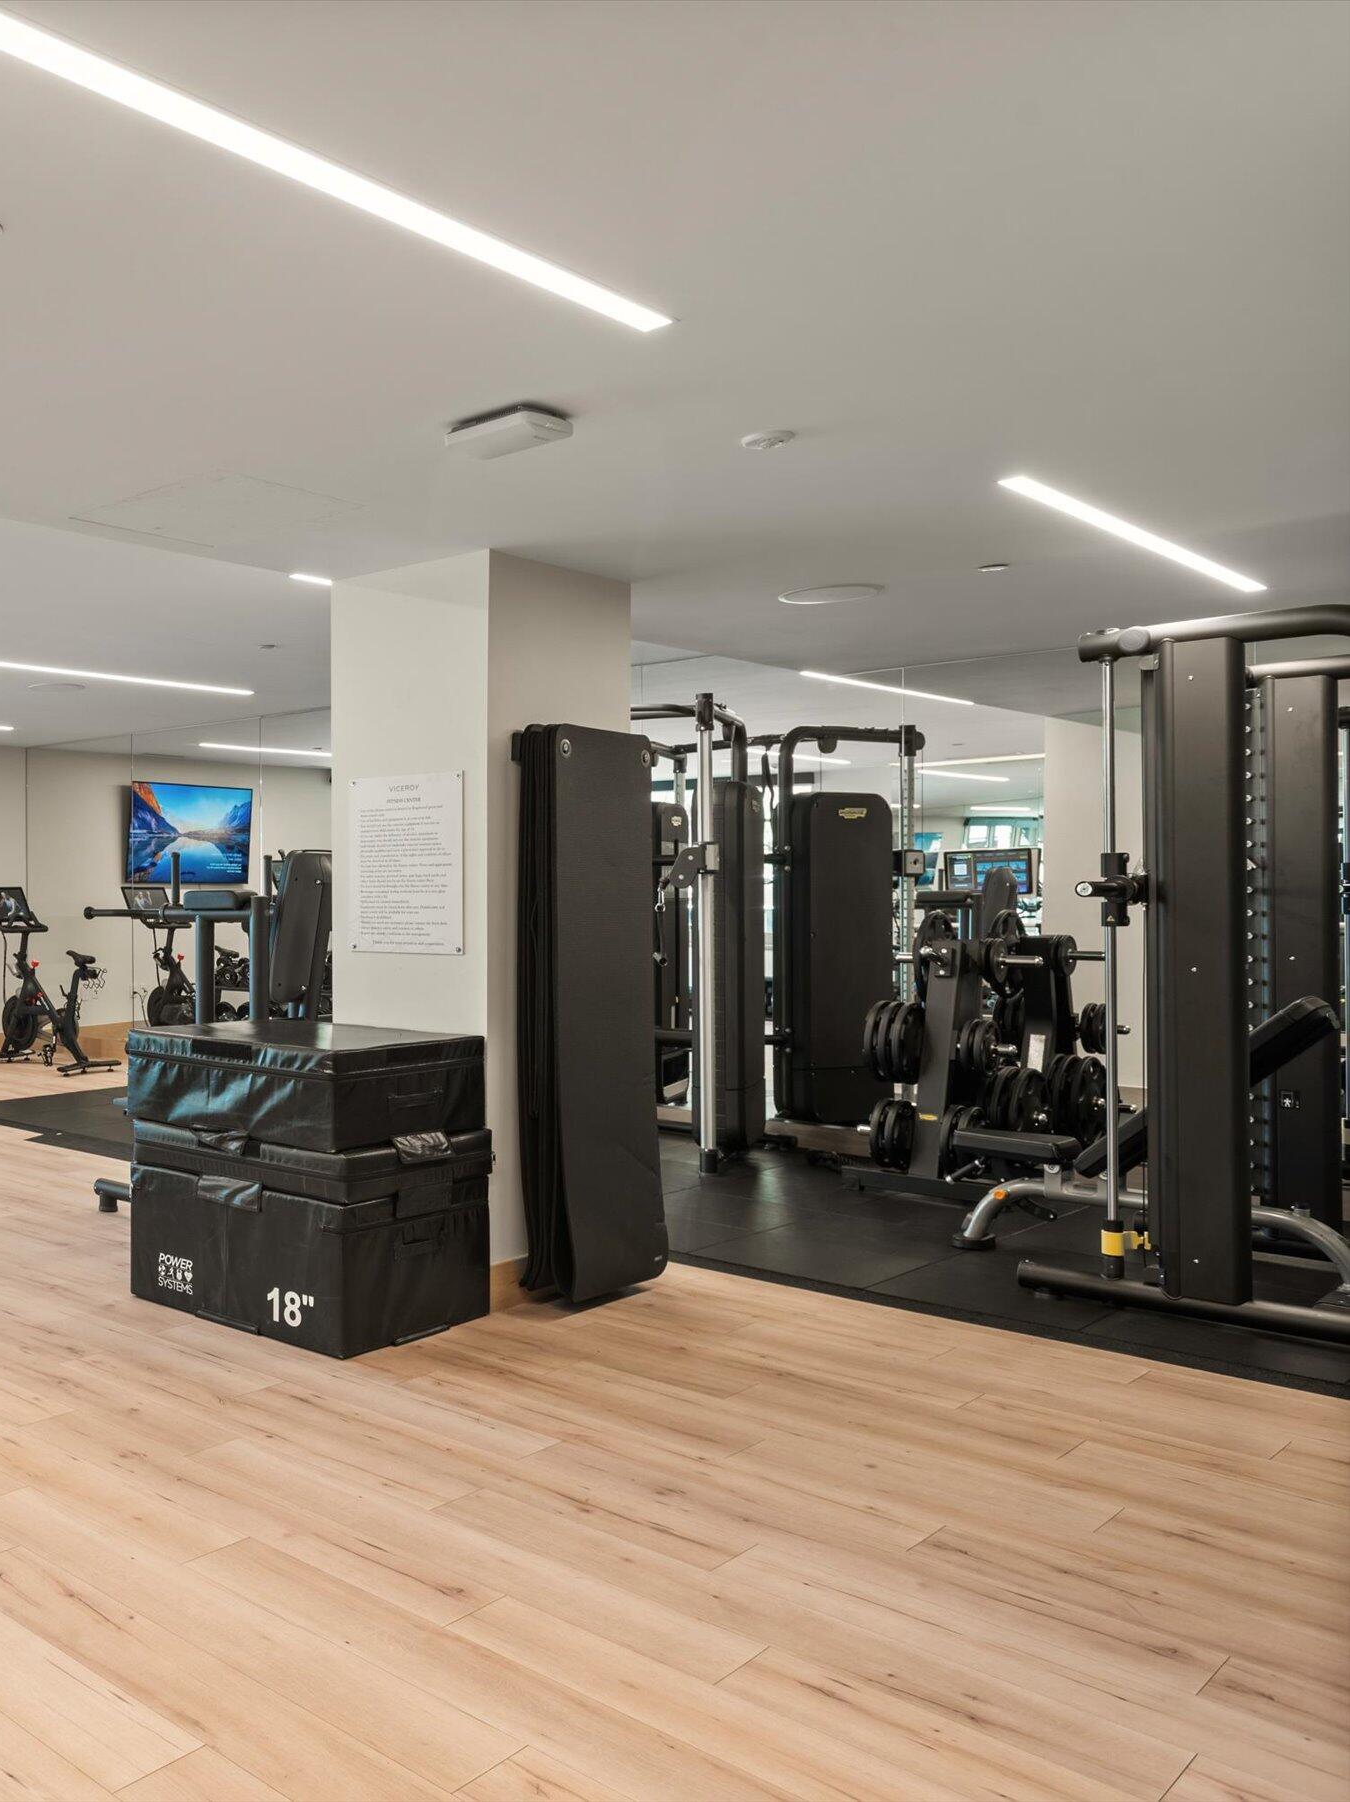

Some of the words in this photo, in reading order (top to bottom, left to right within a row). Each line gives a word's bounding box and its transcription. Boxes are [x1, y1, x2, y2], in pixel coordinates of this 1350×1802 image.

[388, 784, 420, 792] VICEROY
[158, 1253, 193, 1271] POWER
[158, 1276, 193, 1295] SYSTEMS
